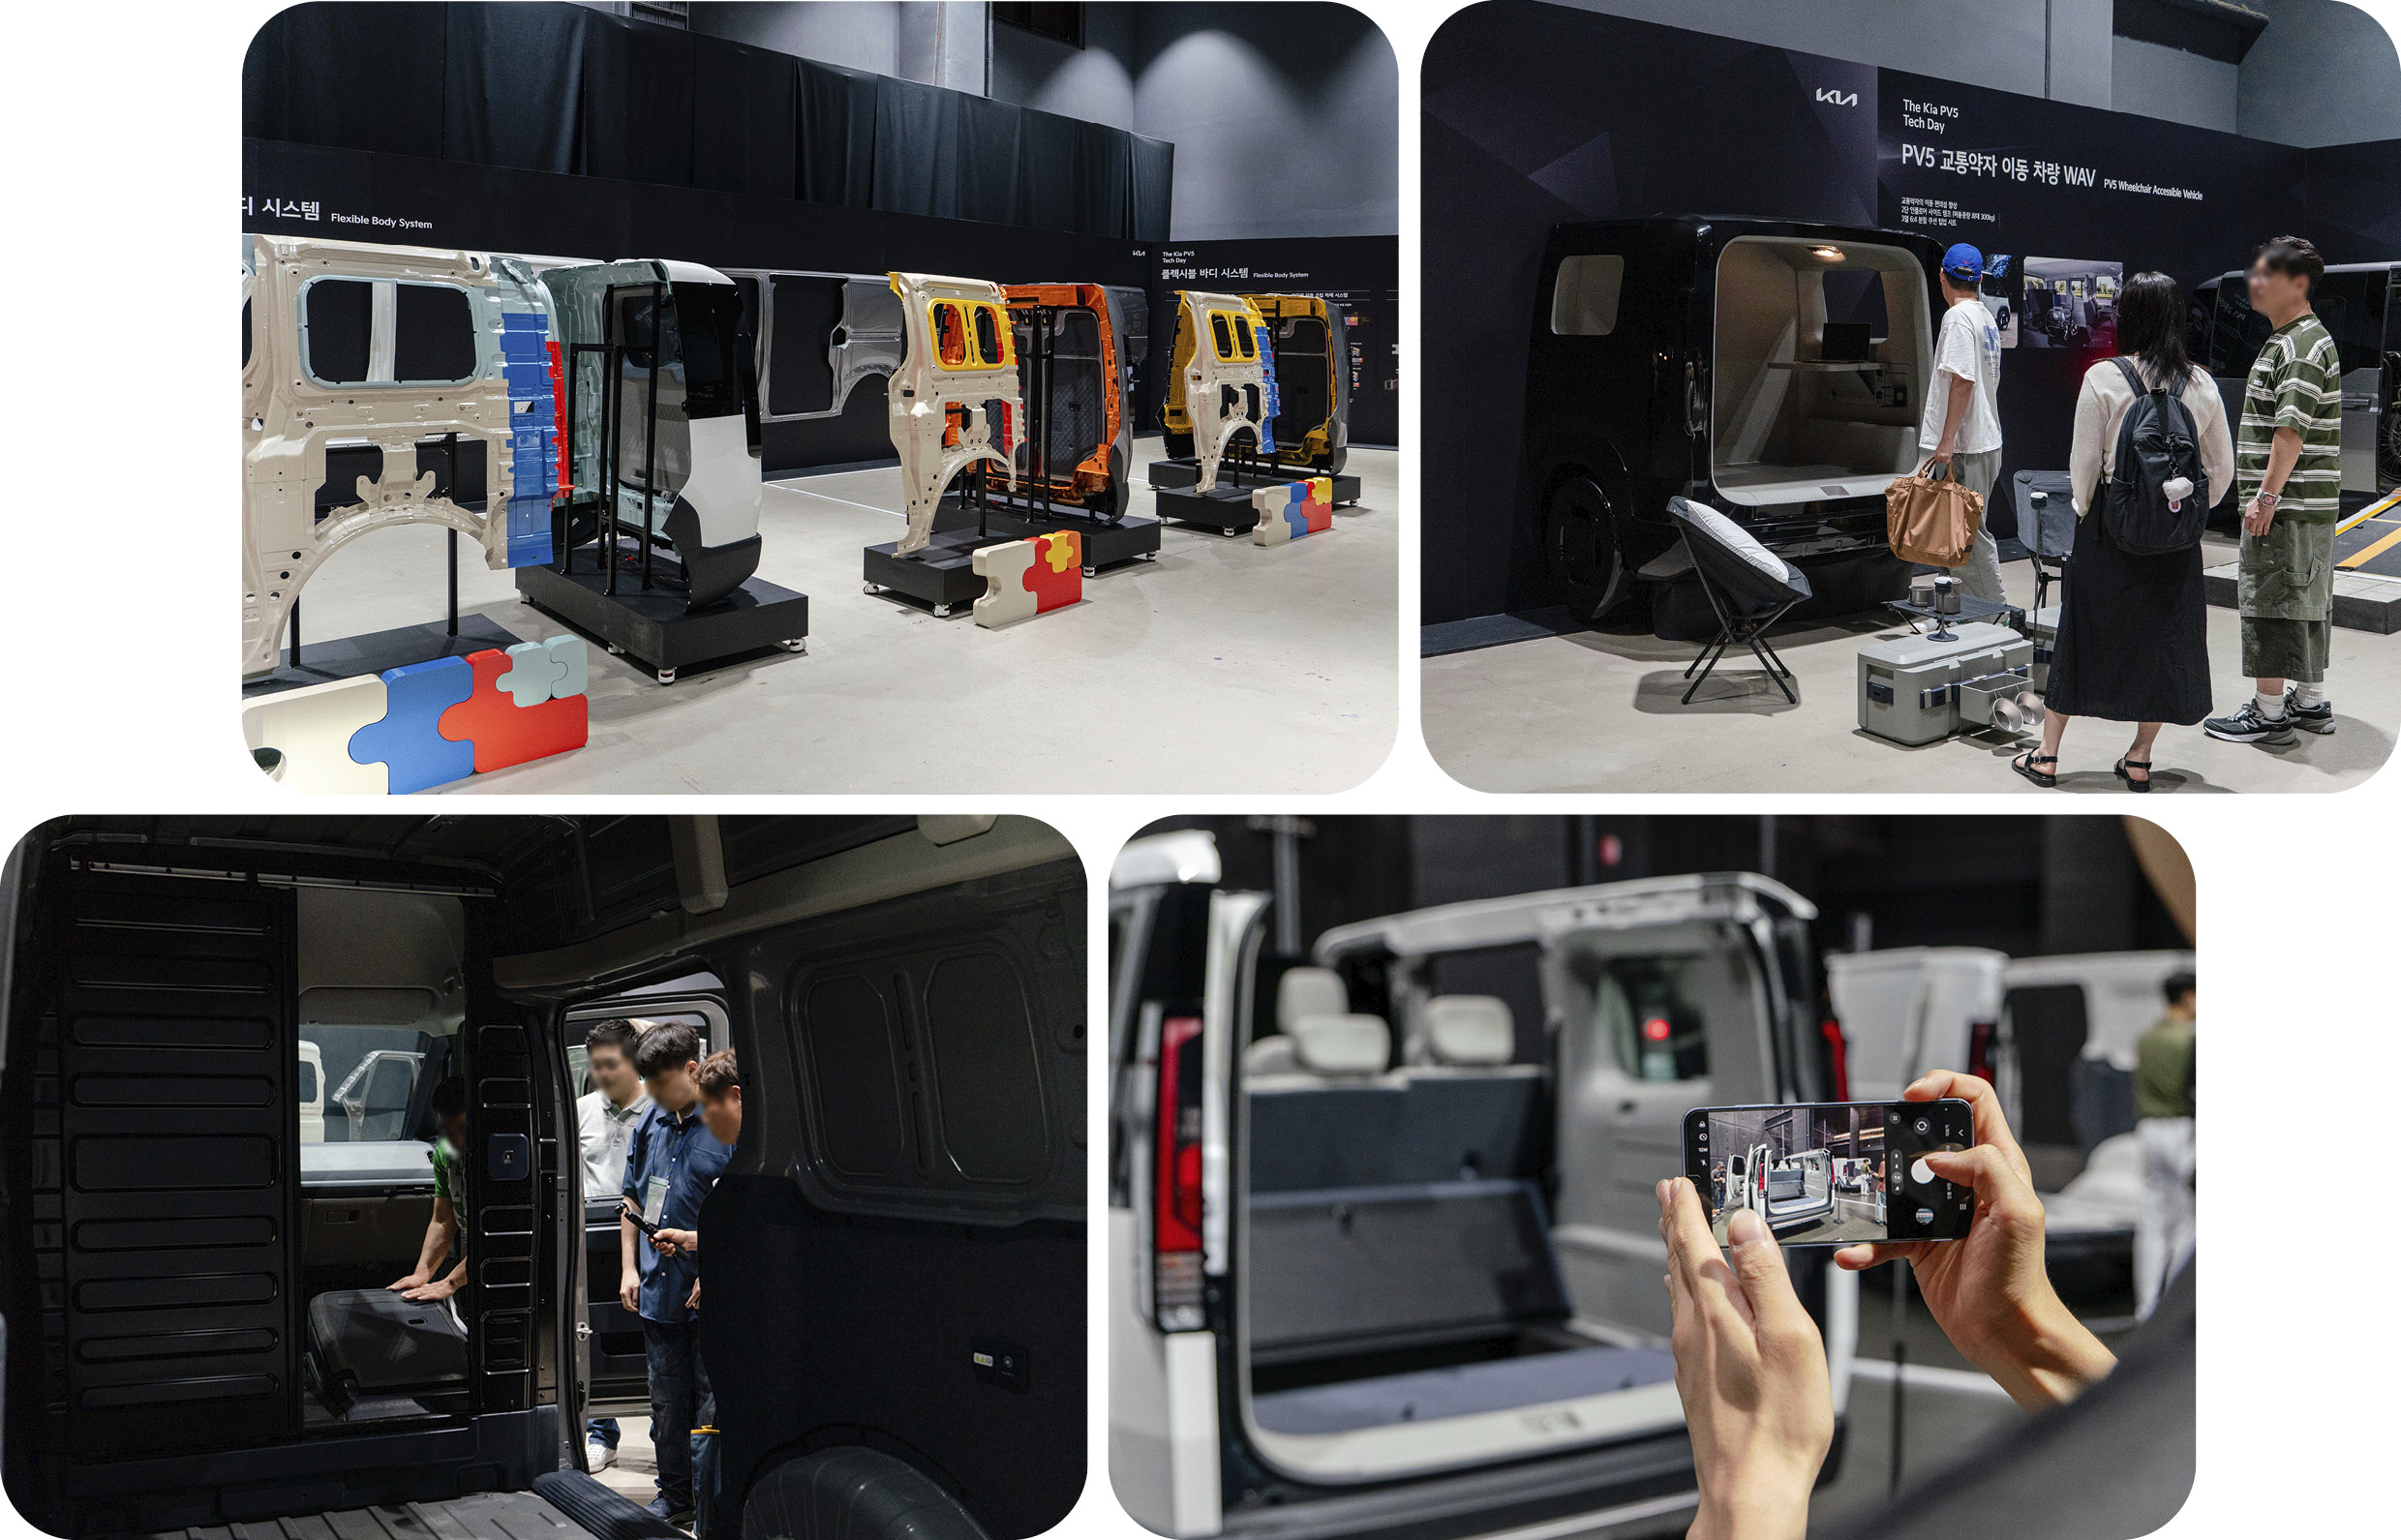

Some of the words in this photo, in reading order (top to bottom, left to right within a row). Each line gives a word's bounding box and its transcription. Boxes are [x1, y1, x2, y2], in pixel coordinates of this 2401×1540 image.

[1816, 87, 1858, 107] KIA
[1903, 99, 1921, 112] The
[1924, 103, 1937, 115] Kia
[1940, 106, 1959, 118] PV5
[1903, 114, 1925, 129] Tech
[1928, 118, 1945, 134] Day
[1902, 143, 1934, 167] PV5
[1940, 150, 1997, 177] 교통약자
[2002, 157, 2029, 182] 이동
[2033, 161, 2060, 186] 차량
[2064, 166, 2096, 188] WAV
[2104, 179, 2116, 190] PV5
[2118, 180, 2151, 194] Wheelchair
[2153, 185, 2181, 198] Accessible
[2183, 189, 2203, 201] Vehicle
[262, 198, 319, 221] 시스템
[331, 214, 370, 225] Flexible
[372, 217, 396, 227] Body
[399, 219, 432, 229] System
[1162, 269, 1197, 279] 플렉시블
[1200, 268, 1218, 279] 바디
[1221, 267, 1249, 279] 시스템
